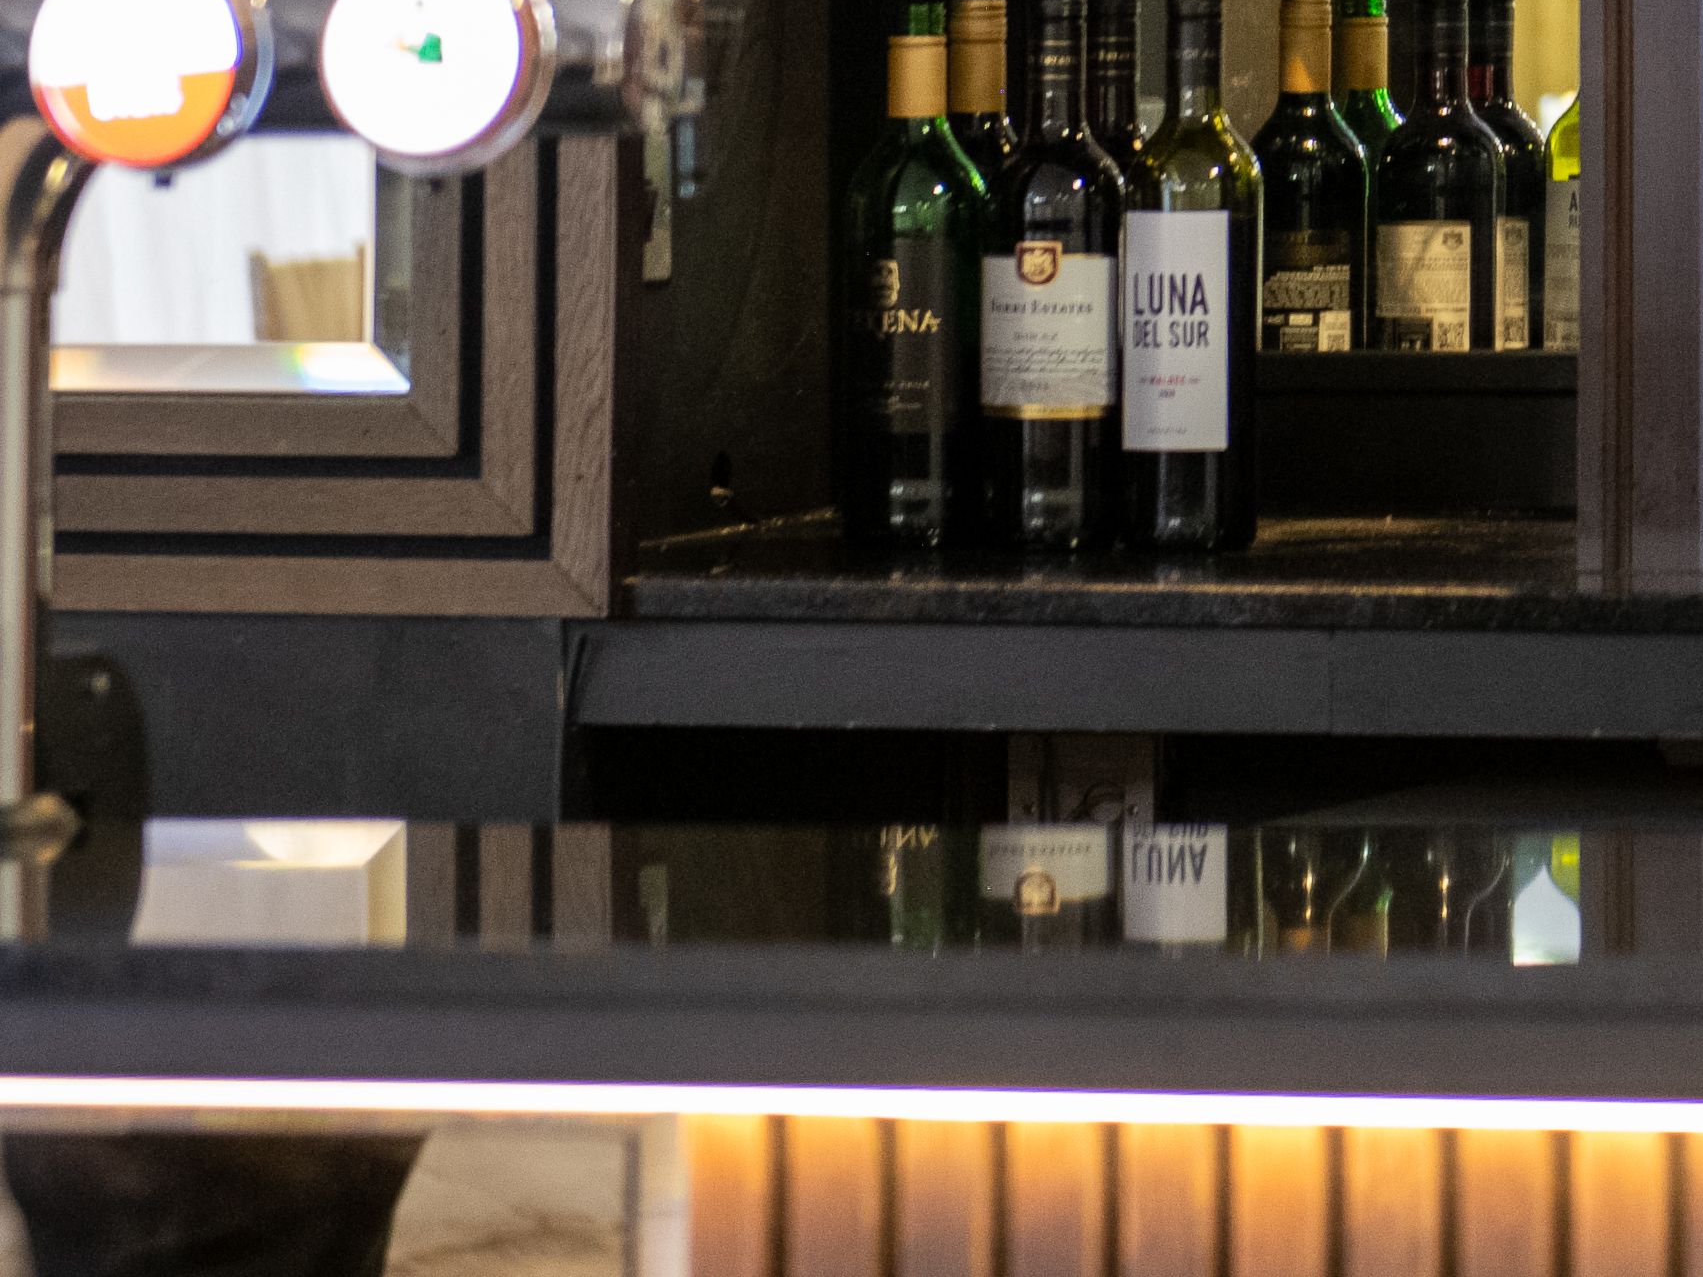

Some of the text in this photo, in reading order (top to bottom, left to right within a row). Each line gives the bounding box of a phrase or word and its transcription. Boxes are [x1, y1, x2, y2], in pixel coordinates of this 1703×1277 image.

[1133, 272, 1210, 316] LUNA
[1133, 320, 1210, 348] DEL SUR
